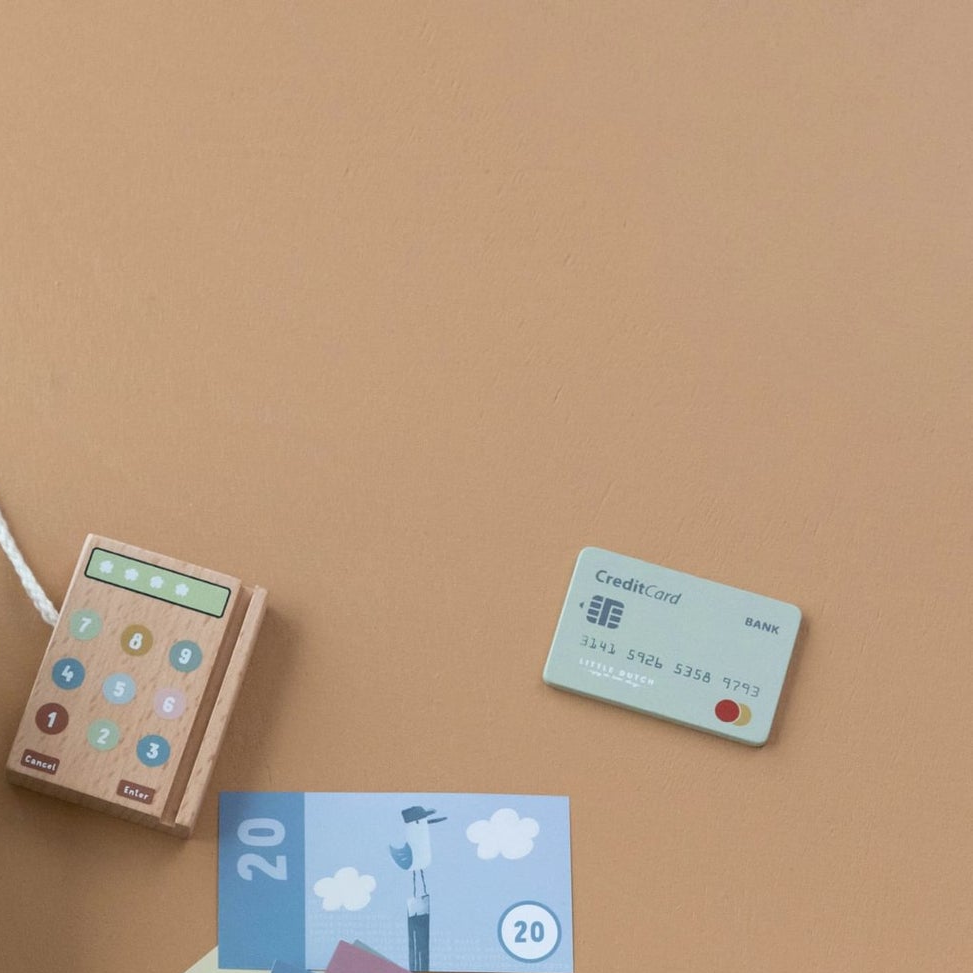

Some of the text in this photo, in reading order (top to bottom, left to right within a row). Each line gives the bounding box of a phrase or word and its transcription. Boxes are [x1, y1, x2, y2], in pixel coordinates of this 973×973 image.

[595, 569, 682, 605] CreditCard
[79, 617, 92, 633] 7
[744, 617, 780, 635] BANK
[129, 632, 143, 650] 8
[179, 648, 193, 665] 9
[61, 665, 74, 682] 4
[579, 635, 761, 698] 3141 5926 5358 9793
[579, 657, 614, 673] LITTLE
[618, 669, 655, 686] DUTCH
[113, 681, 126, 698] 5
[162, 696, 176, 713] 6
[47, 711, 58, 728] 1
[97, 728, 110, 745] 2
[146, 742, 160, 759] 3
[24, 754, 57, 772] Cancel
[123, 785, 150, 801] Enter
[237, 817, 288, 881] 20
[513, 919, 545, 943] 20
